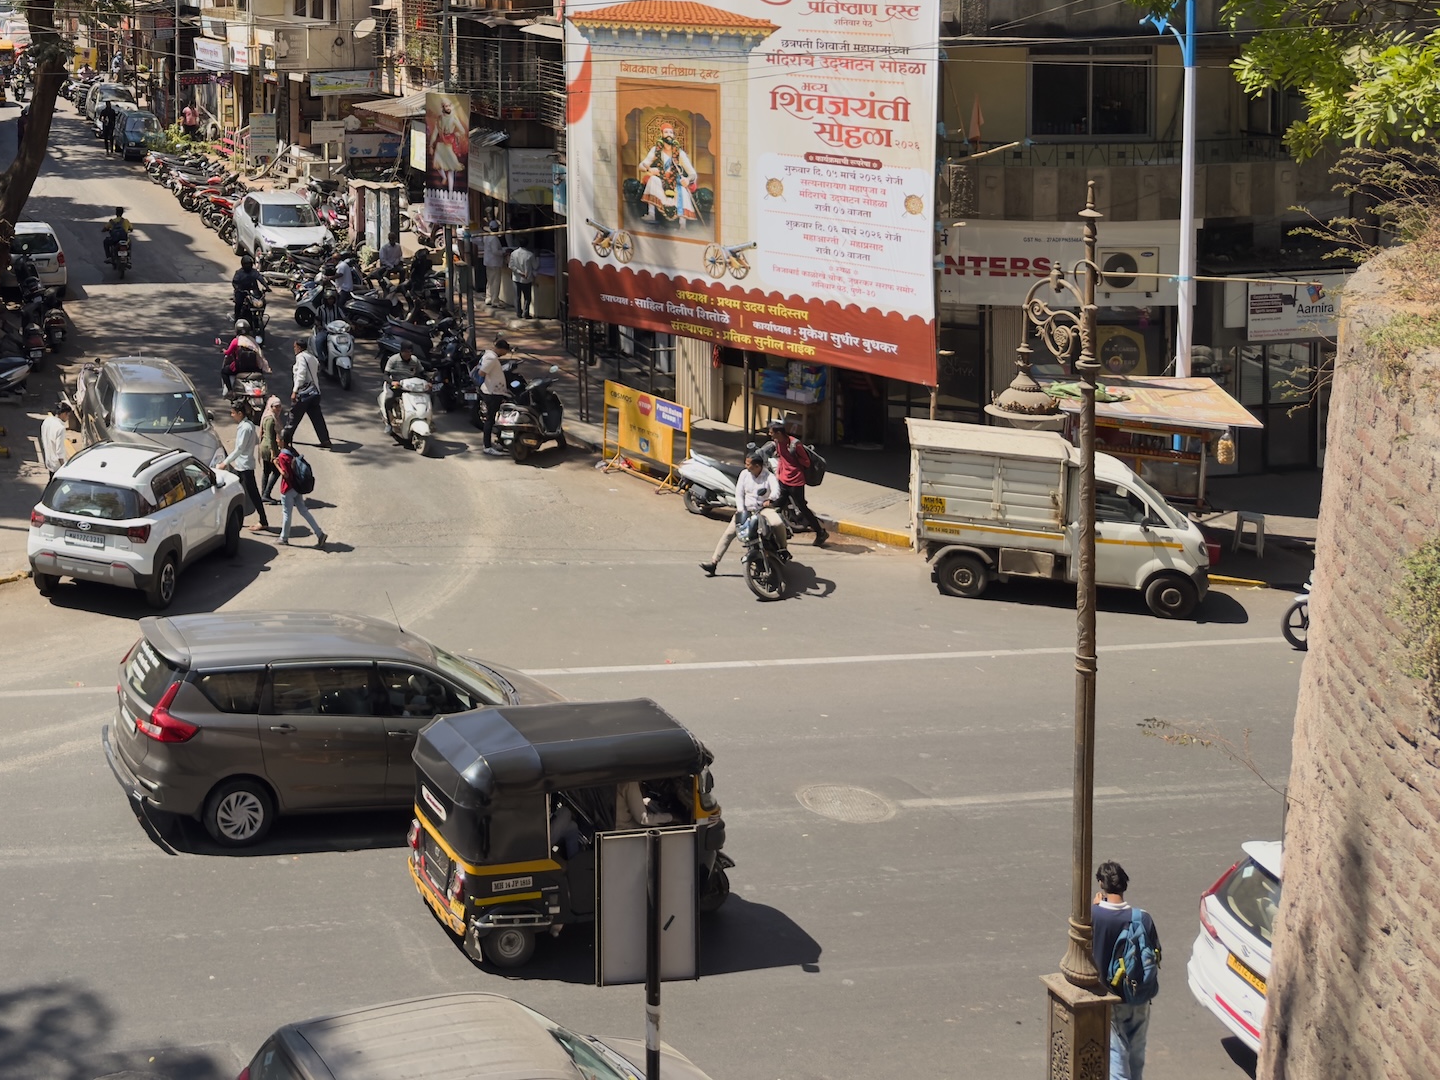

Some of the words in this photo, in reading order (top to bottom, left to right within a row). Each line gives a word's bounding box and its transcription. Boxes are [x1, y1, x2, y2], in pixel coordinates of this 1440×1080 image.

[833, 18, 861, 28] शनिवार
[863, 19, 874, 28] पेठ
[780, 39, 813, 51] छत्रपती
[816, 39, 850, 53] शिवाजी
[620, 60, 659, 75] शिवकाल
[765, 50, 814, 69] मंदिराचे
[879, 56, 927, 76] सोहळा
[801, 82, 828, 93] भव्य
[769, 84, 912, 122] शिवजयंती
[812, 117, 894, 149] सोहळा
[895, 140, 921, 153] २०२६
[784, 165, 811, 177] गुरुवार
[841, 170, 856, 180] मार्च
[859, 173, 882, 184] २०२६
[886, 174, 903, 186] रोजी
[800, 178, 847, 191] सत्यनारायण
[799, 189, 827, 200] मंदिराचे
[862, 196, 888, 208] सोहळा
[814, 203, 831, 213] रात्री
[847, 208, 871, 218] वाजता
[785, 219, 813, 231] शुक्रवार
[841, 225, 857, 236] मार्च
[859, 228, 882, 239] २०२६
[885, 231, 902, 242] रोजी
[803, 232, 839, 245] महाआरती
[849, 240, 884, 252] महाप्रसाद
[815, 246, 831, 256] रात्री
[847, 251, 870, 262] वाजता
[600, 293, 629, 306] उपाध्यक्ष
[634, 296, 665, 313] साहिल
[666, 300, 695, 318] दिलीप
[697, 306, 731, 325] शितोळे
[676, 289, 709, 304] अध्यक्ष
[717, 296, 741, 310] प्रथम
[743, 301, 766, 314] उदय
[768, 302, 809, 321] सदिस्तप
[1296, 302, 1334, 315] Aarnira
[671, 318, 714, 338] संस्थापक
[722, 328, 752, 345] प्रतिक
[753, 334, 785, 351] सुनील
[786, 340, 816, 356] नाईक
[752, 320, 792, 335] कार्याध्यक्ष
[798, 324, 829, 341] मुकेश
[830, 331, 860, 349] सुधीर
[862, 337, 898, 355] बुधकर
[638, 400, 651, 410] STOP
[493, 882, 504, 891] MH
[505, 881, 511, 889] 14
